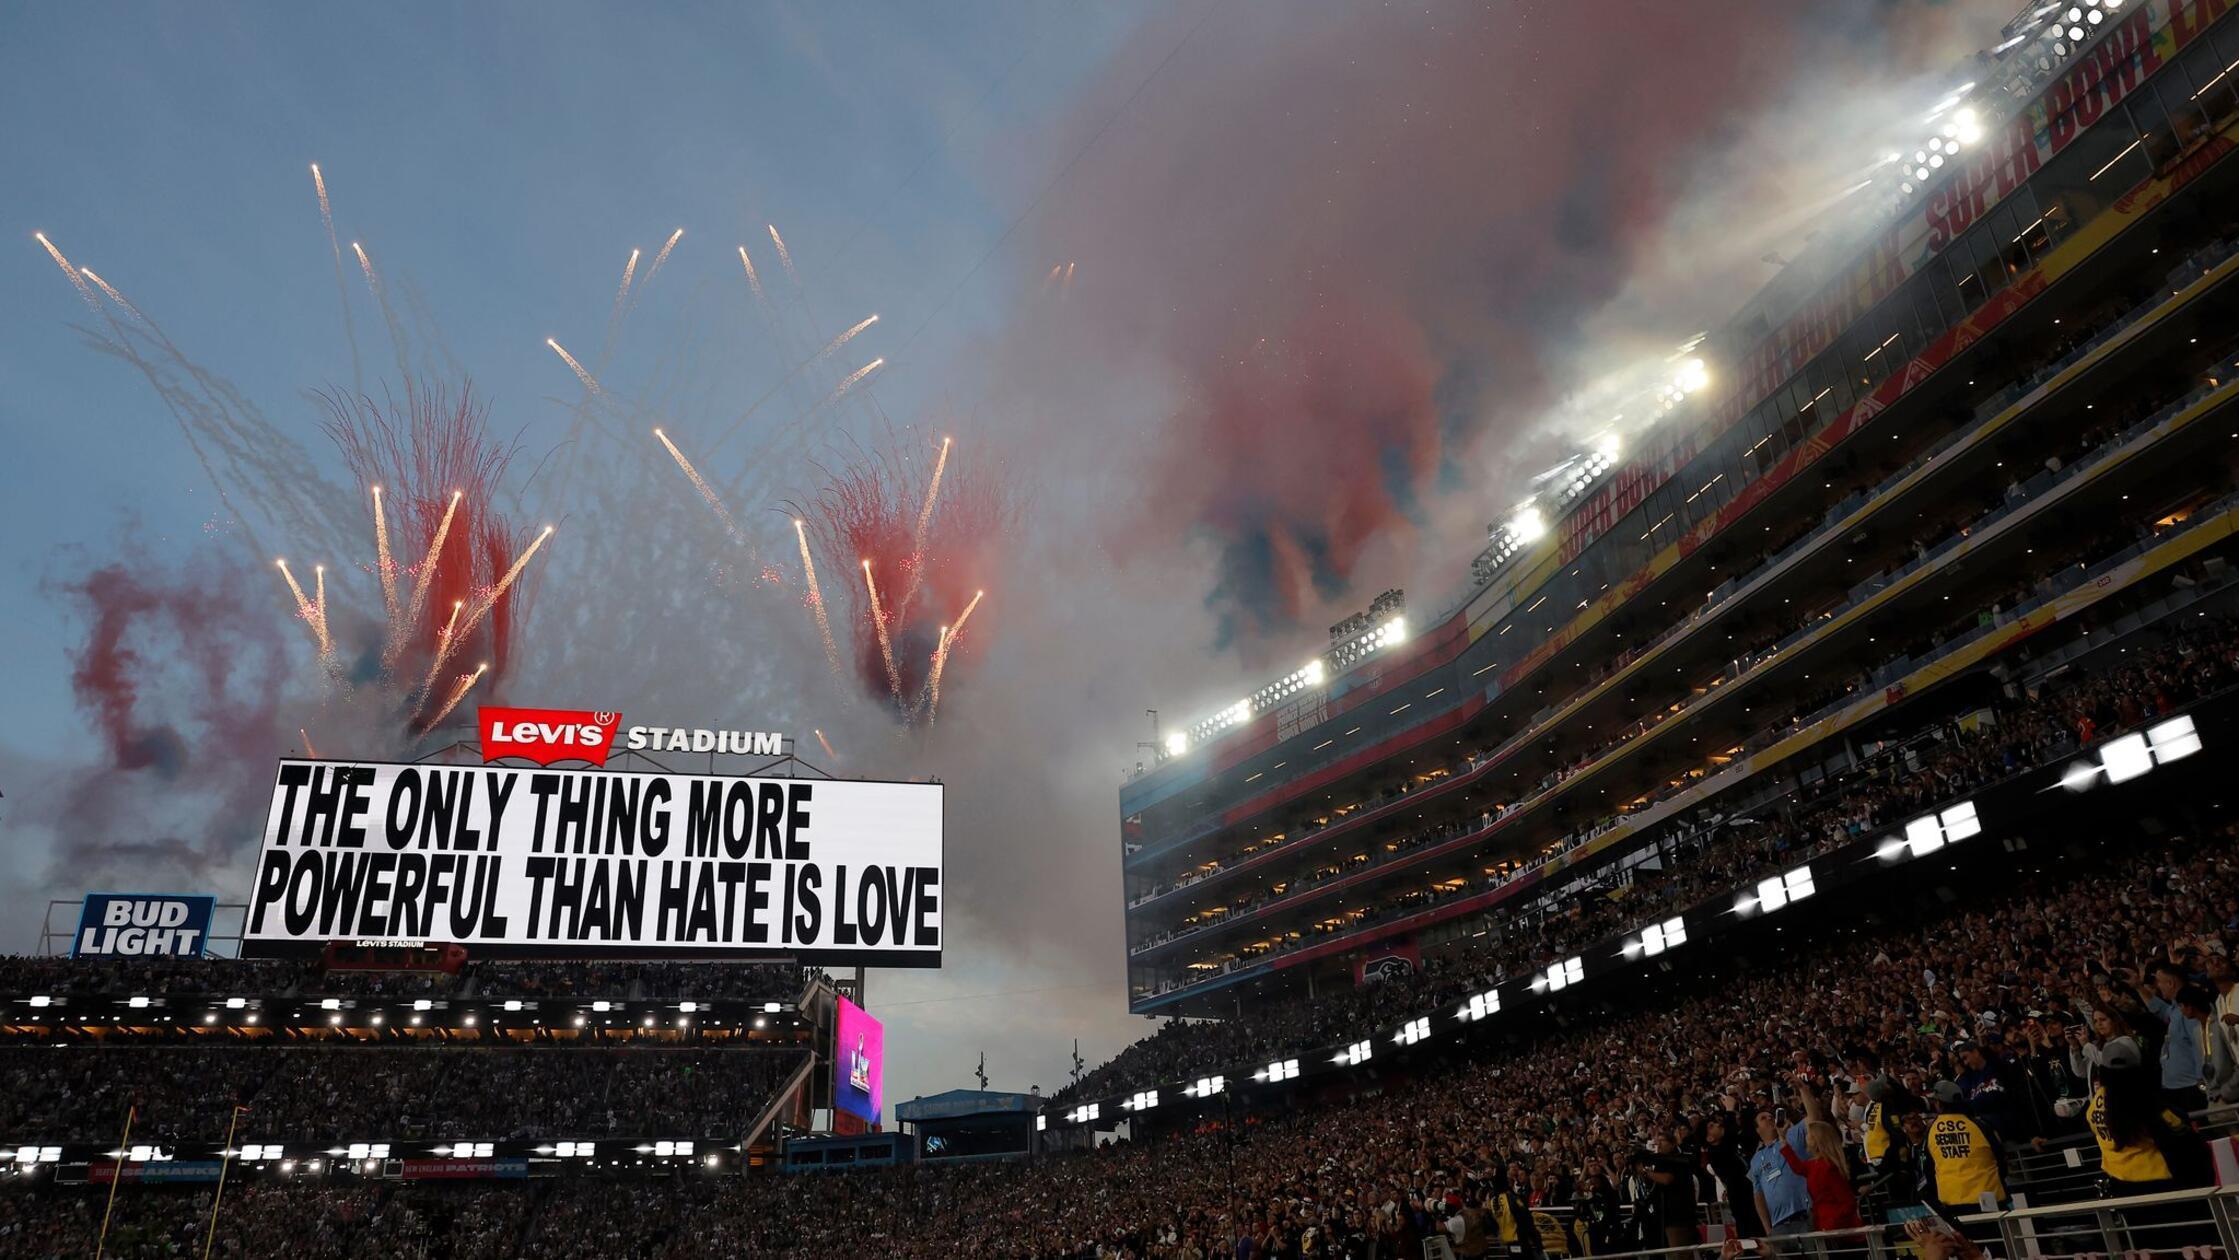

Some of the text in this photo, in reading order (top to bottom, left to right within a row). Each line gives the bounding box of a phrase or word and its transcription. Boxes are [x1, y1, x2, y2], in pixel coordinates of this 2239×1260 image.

[1925, 112, 2041, 253] SUPER
[2044, 5, 2163, 157] BOWL
[627, 725, 783, 756] STADIUM
[276, 758, 813, 861] THE ONLY THING MORE
[249, 849, 939, 947] POWERFUL THAN HATE IS LOVE
[103, 900, 189, 928] BUD
[80, 927, 200, 956] LIGHT
[388, 940, 424, 948] STADIUM
[1937, 1120, 1966, 1132] CSC
[1935, 1132, 1970, 1145] SECURITY
[1941, 1145, 1970, 1159] STAFF
[121, 1167, 220, 1177] SEAHAWKS
[445, 1162, 526, 1172] PATRIOTS
